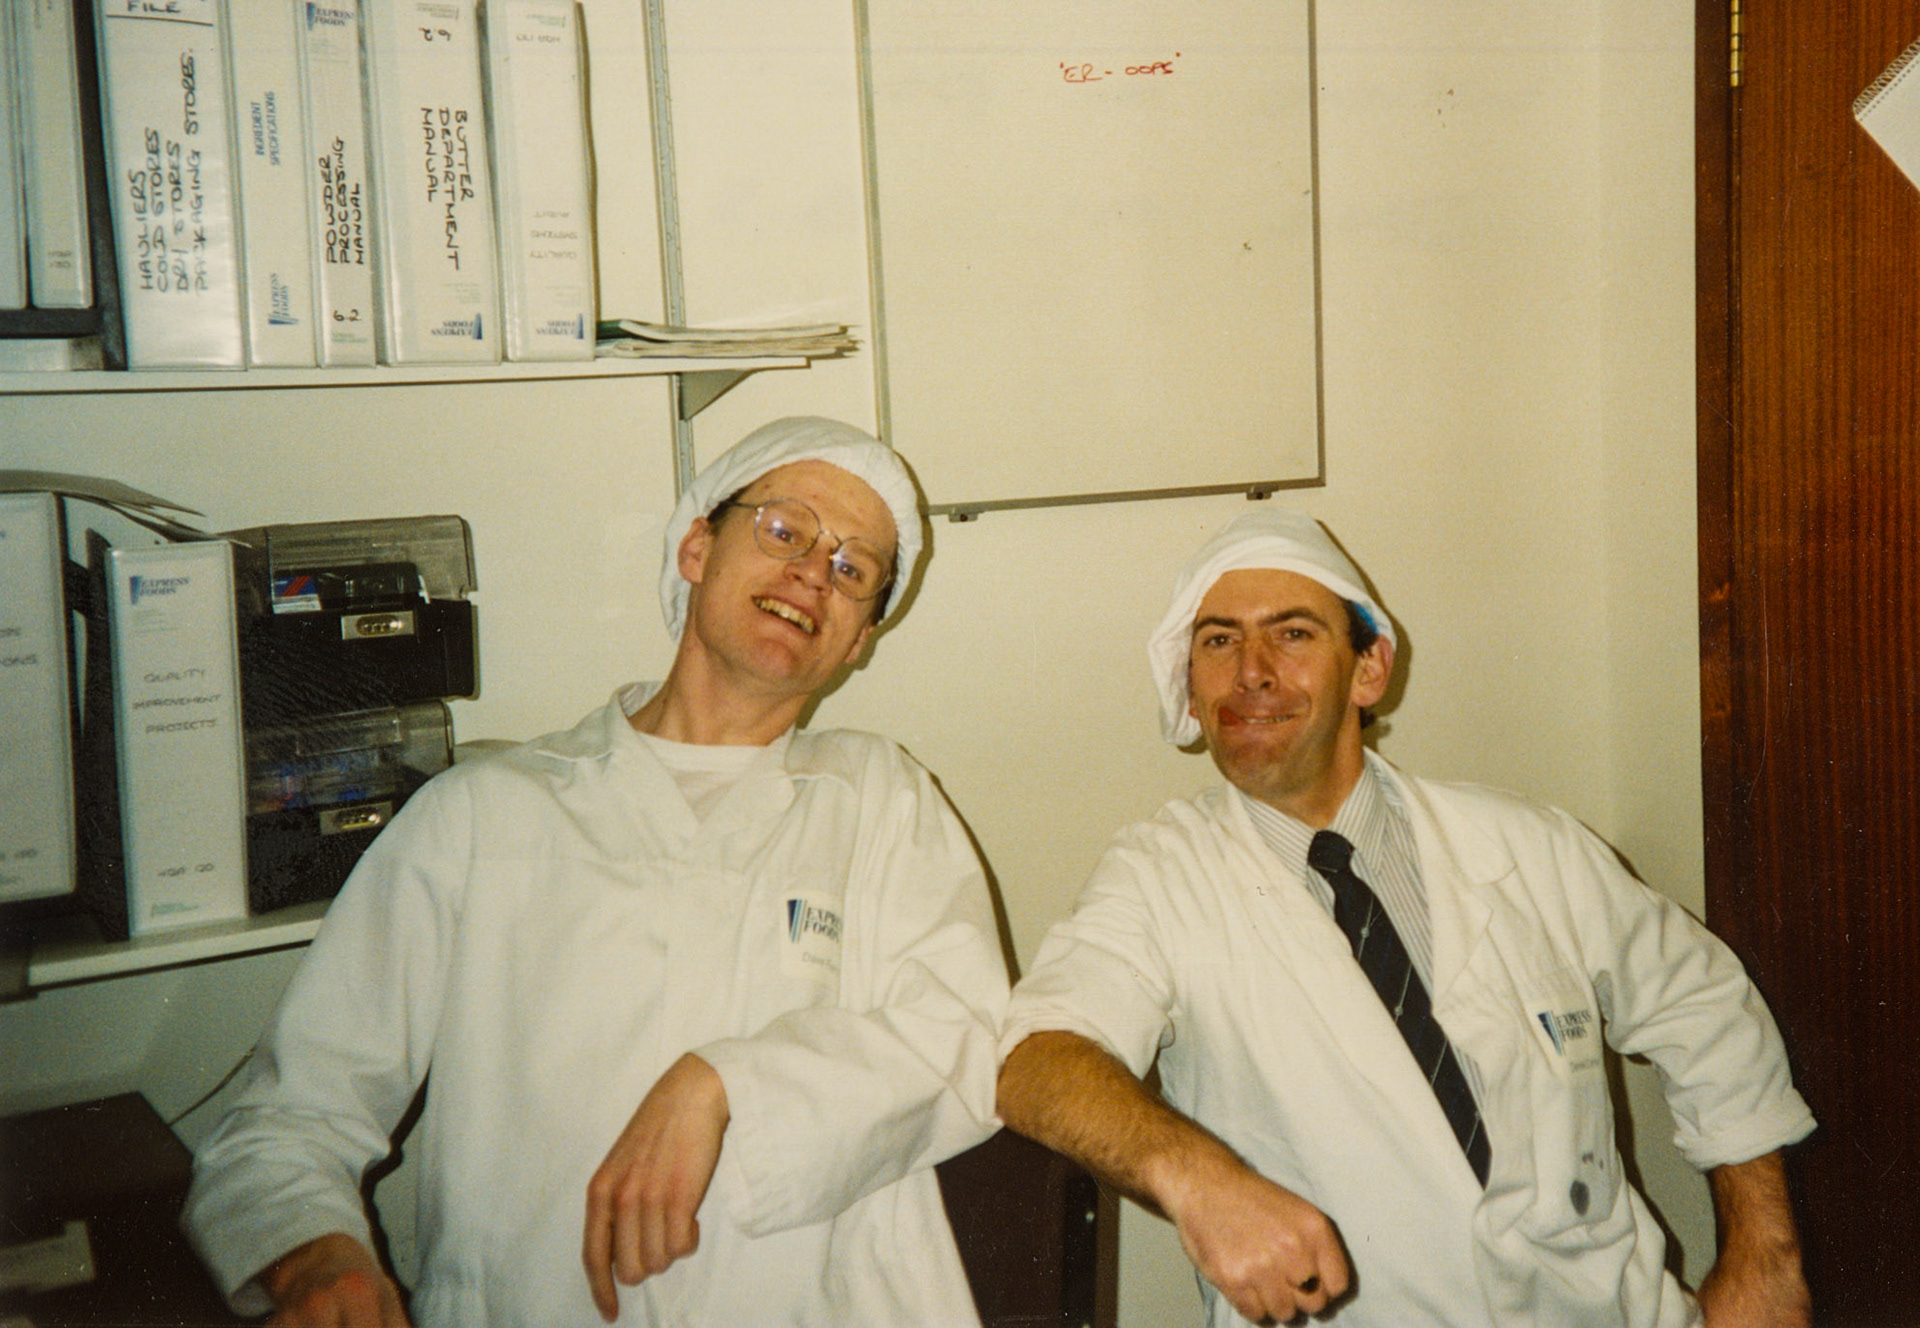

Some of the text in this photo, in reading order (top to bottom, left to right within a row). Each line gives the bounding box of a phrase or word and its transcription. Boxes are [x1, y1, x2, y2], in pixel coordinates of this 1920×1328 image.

[127, 0, 181, 12] FILE
[251, 101, 265, 156] INGREDIENT
[264, 91, 280, 166] SPECIFICATIONS
[421, 108, 438, 202] MANUAL
[455, 110, 474, 201] BUTTER
[128, 168, 153, 290] HAULIERS
[144, 126, 168, 293] COLD STORES
[166, 139, 184, 235] STORES
[187, 149, 208, 292] PACKAGING
[318, 154, 337, 263] POWDER
[332, 136, 350, 263] PROCESSING
[350, 182, 364, 265] MANUAL
[439, 107, 460, 270] DEPARTMENT
[139, 587, 177, 597] FOODS
[141, 577, 190, 588] EXPRESS
[145, 719, 218, 734] PROJECTS
